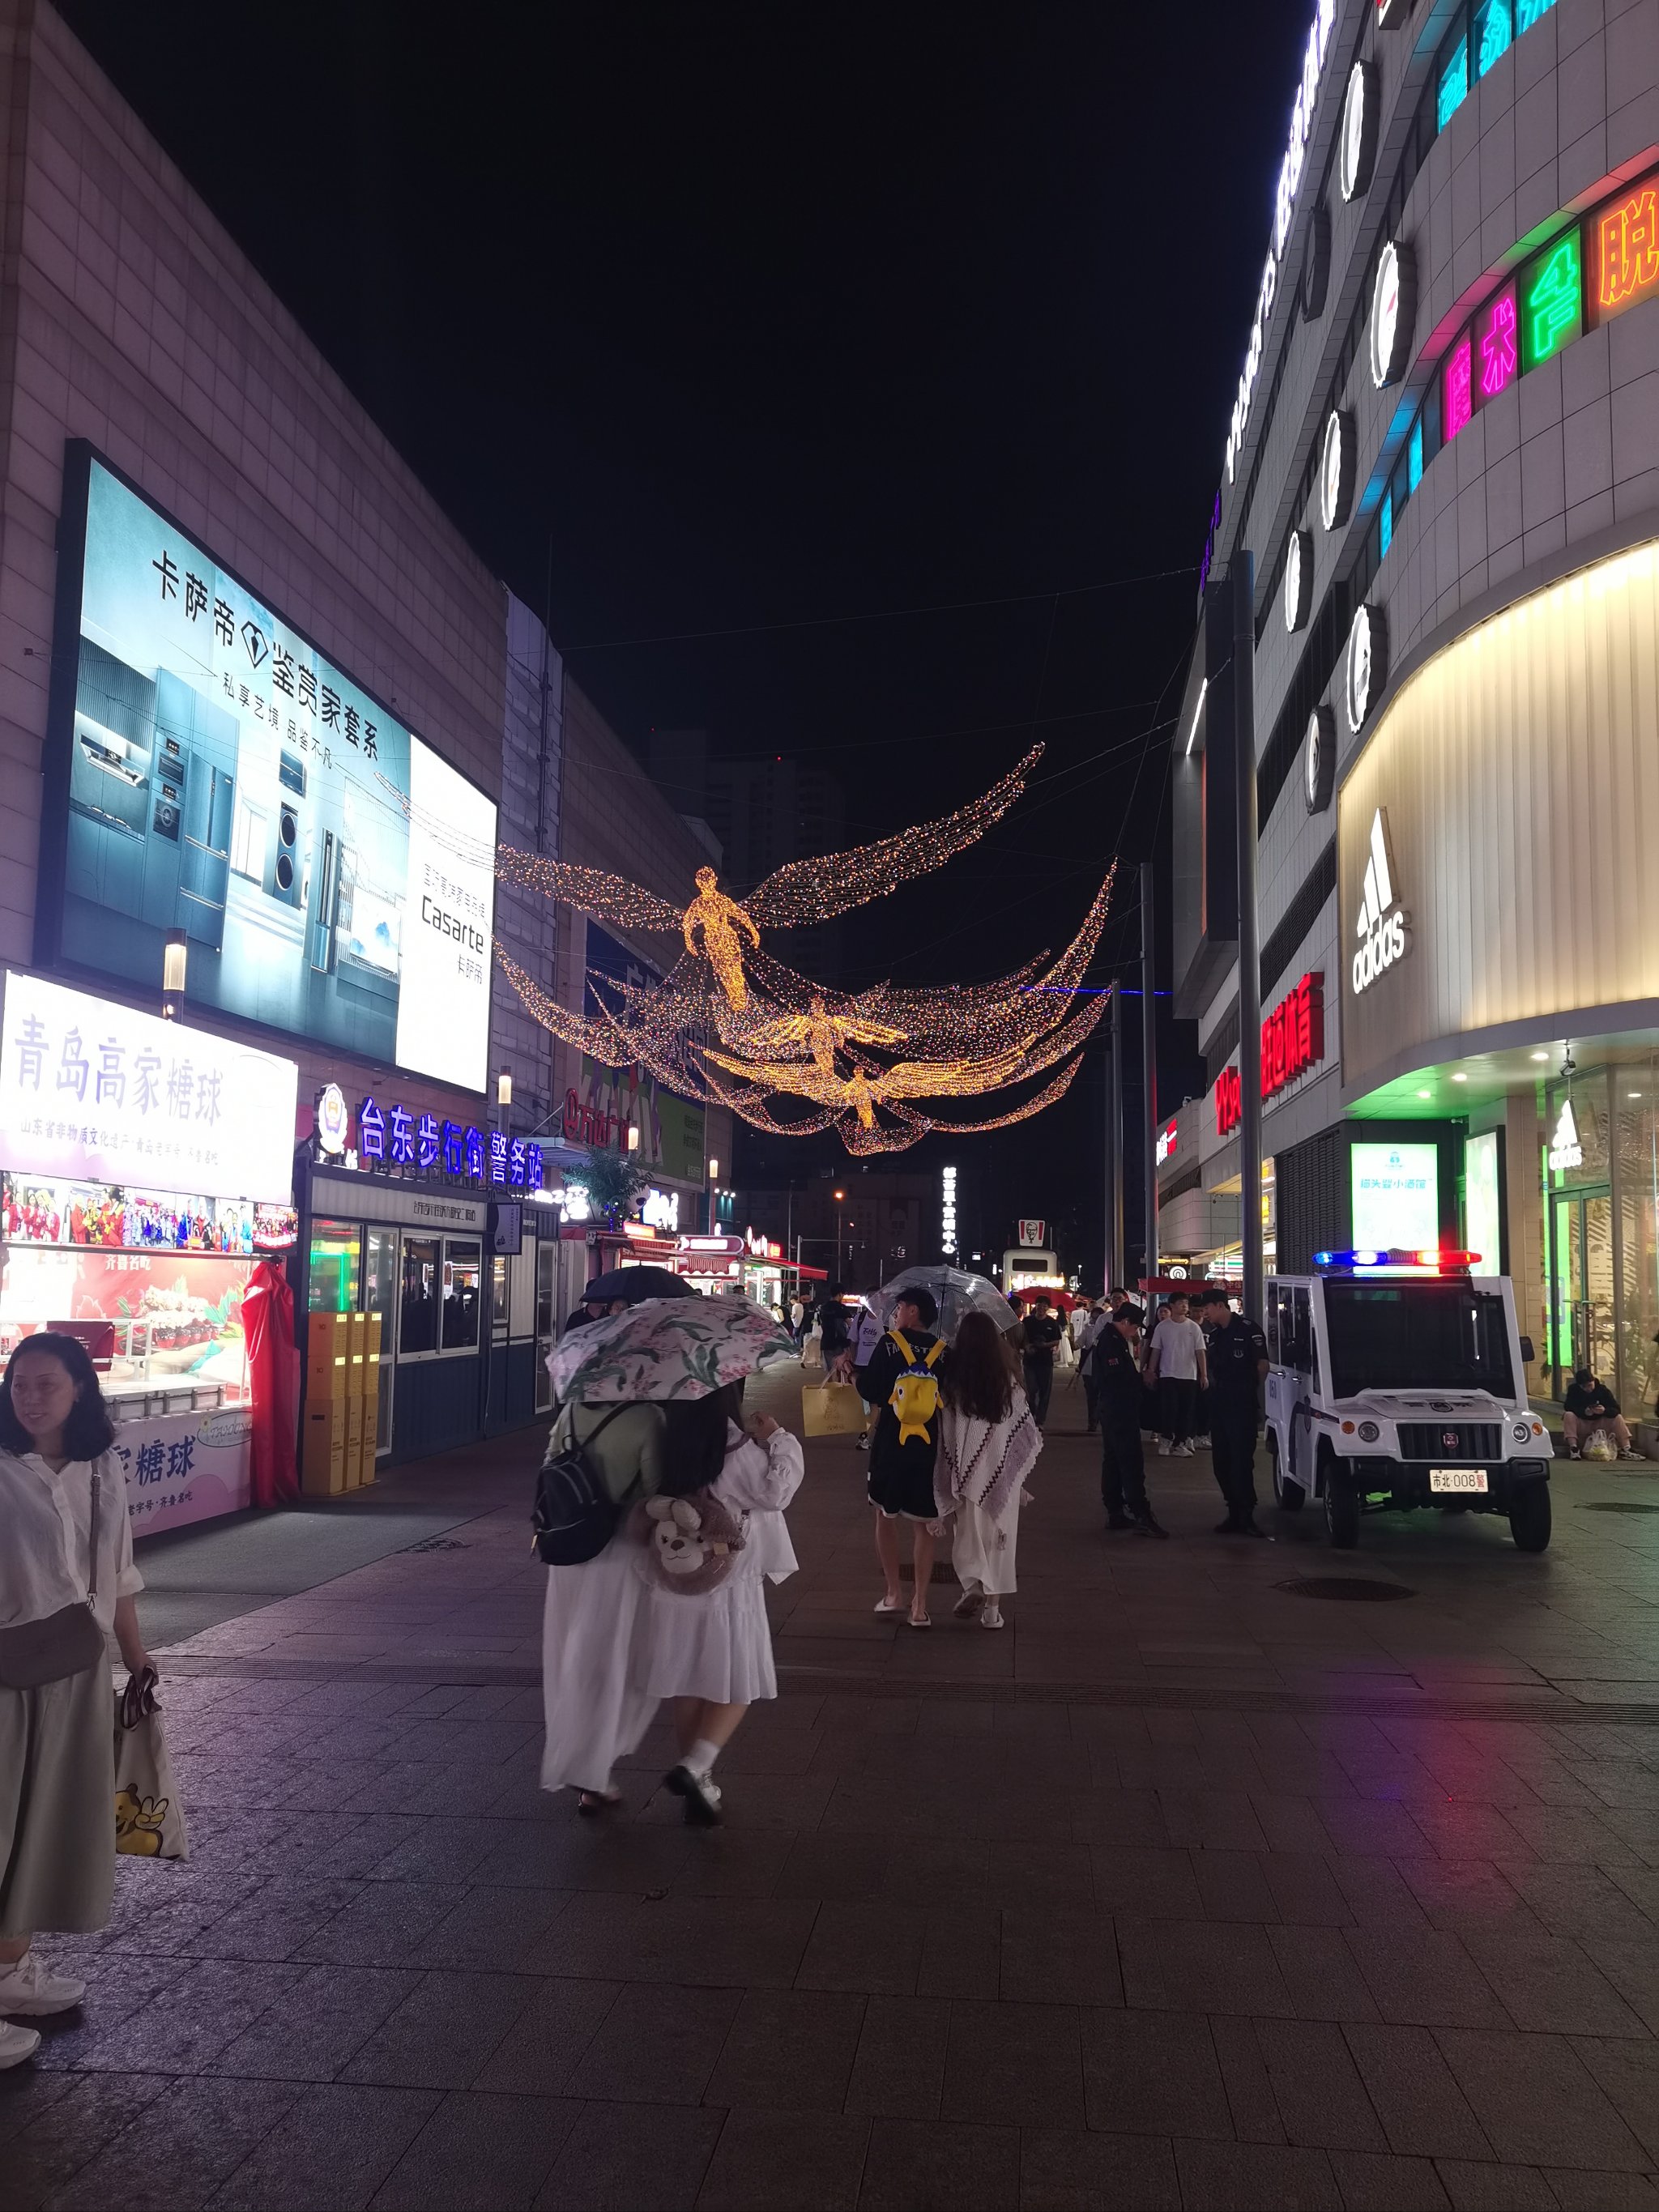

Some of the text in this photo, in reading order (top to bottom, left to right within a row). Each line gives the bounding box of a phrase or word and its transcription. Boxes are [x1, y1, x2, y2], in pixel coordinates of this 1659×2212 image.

[152, 550, 377, 761] 卡萨帝 鉴赏家套系
[223, 671, 332, 769] 私享艺境 品鉴不凡
[422, 895, 484, 954] Casarte
[458, 954, 483, 984] 卡萨帝
[1353, 910, 1405, 994] adidas
[15, 1012, 224, 1127] 青岛高家糖球
